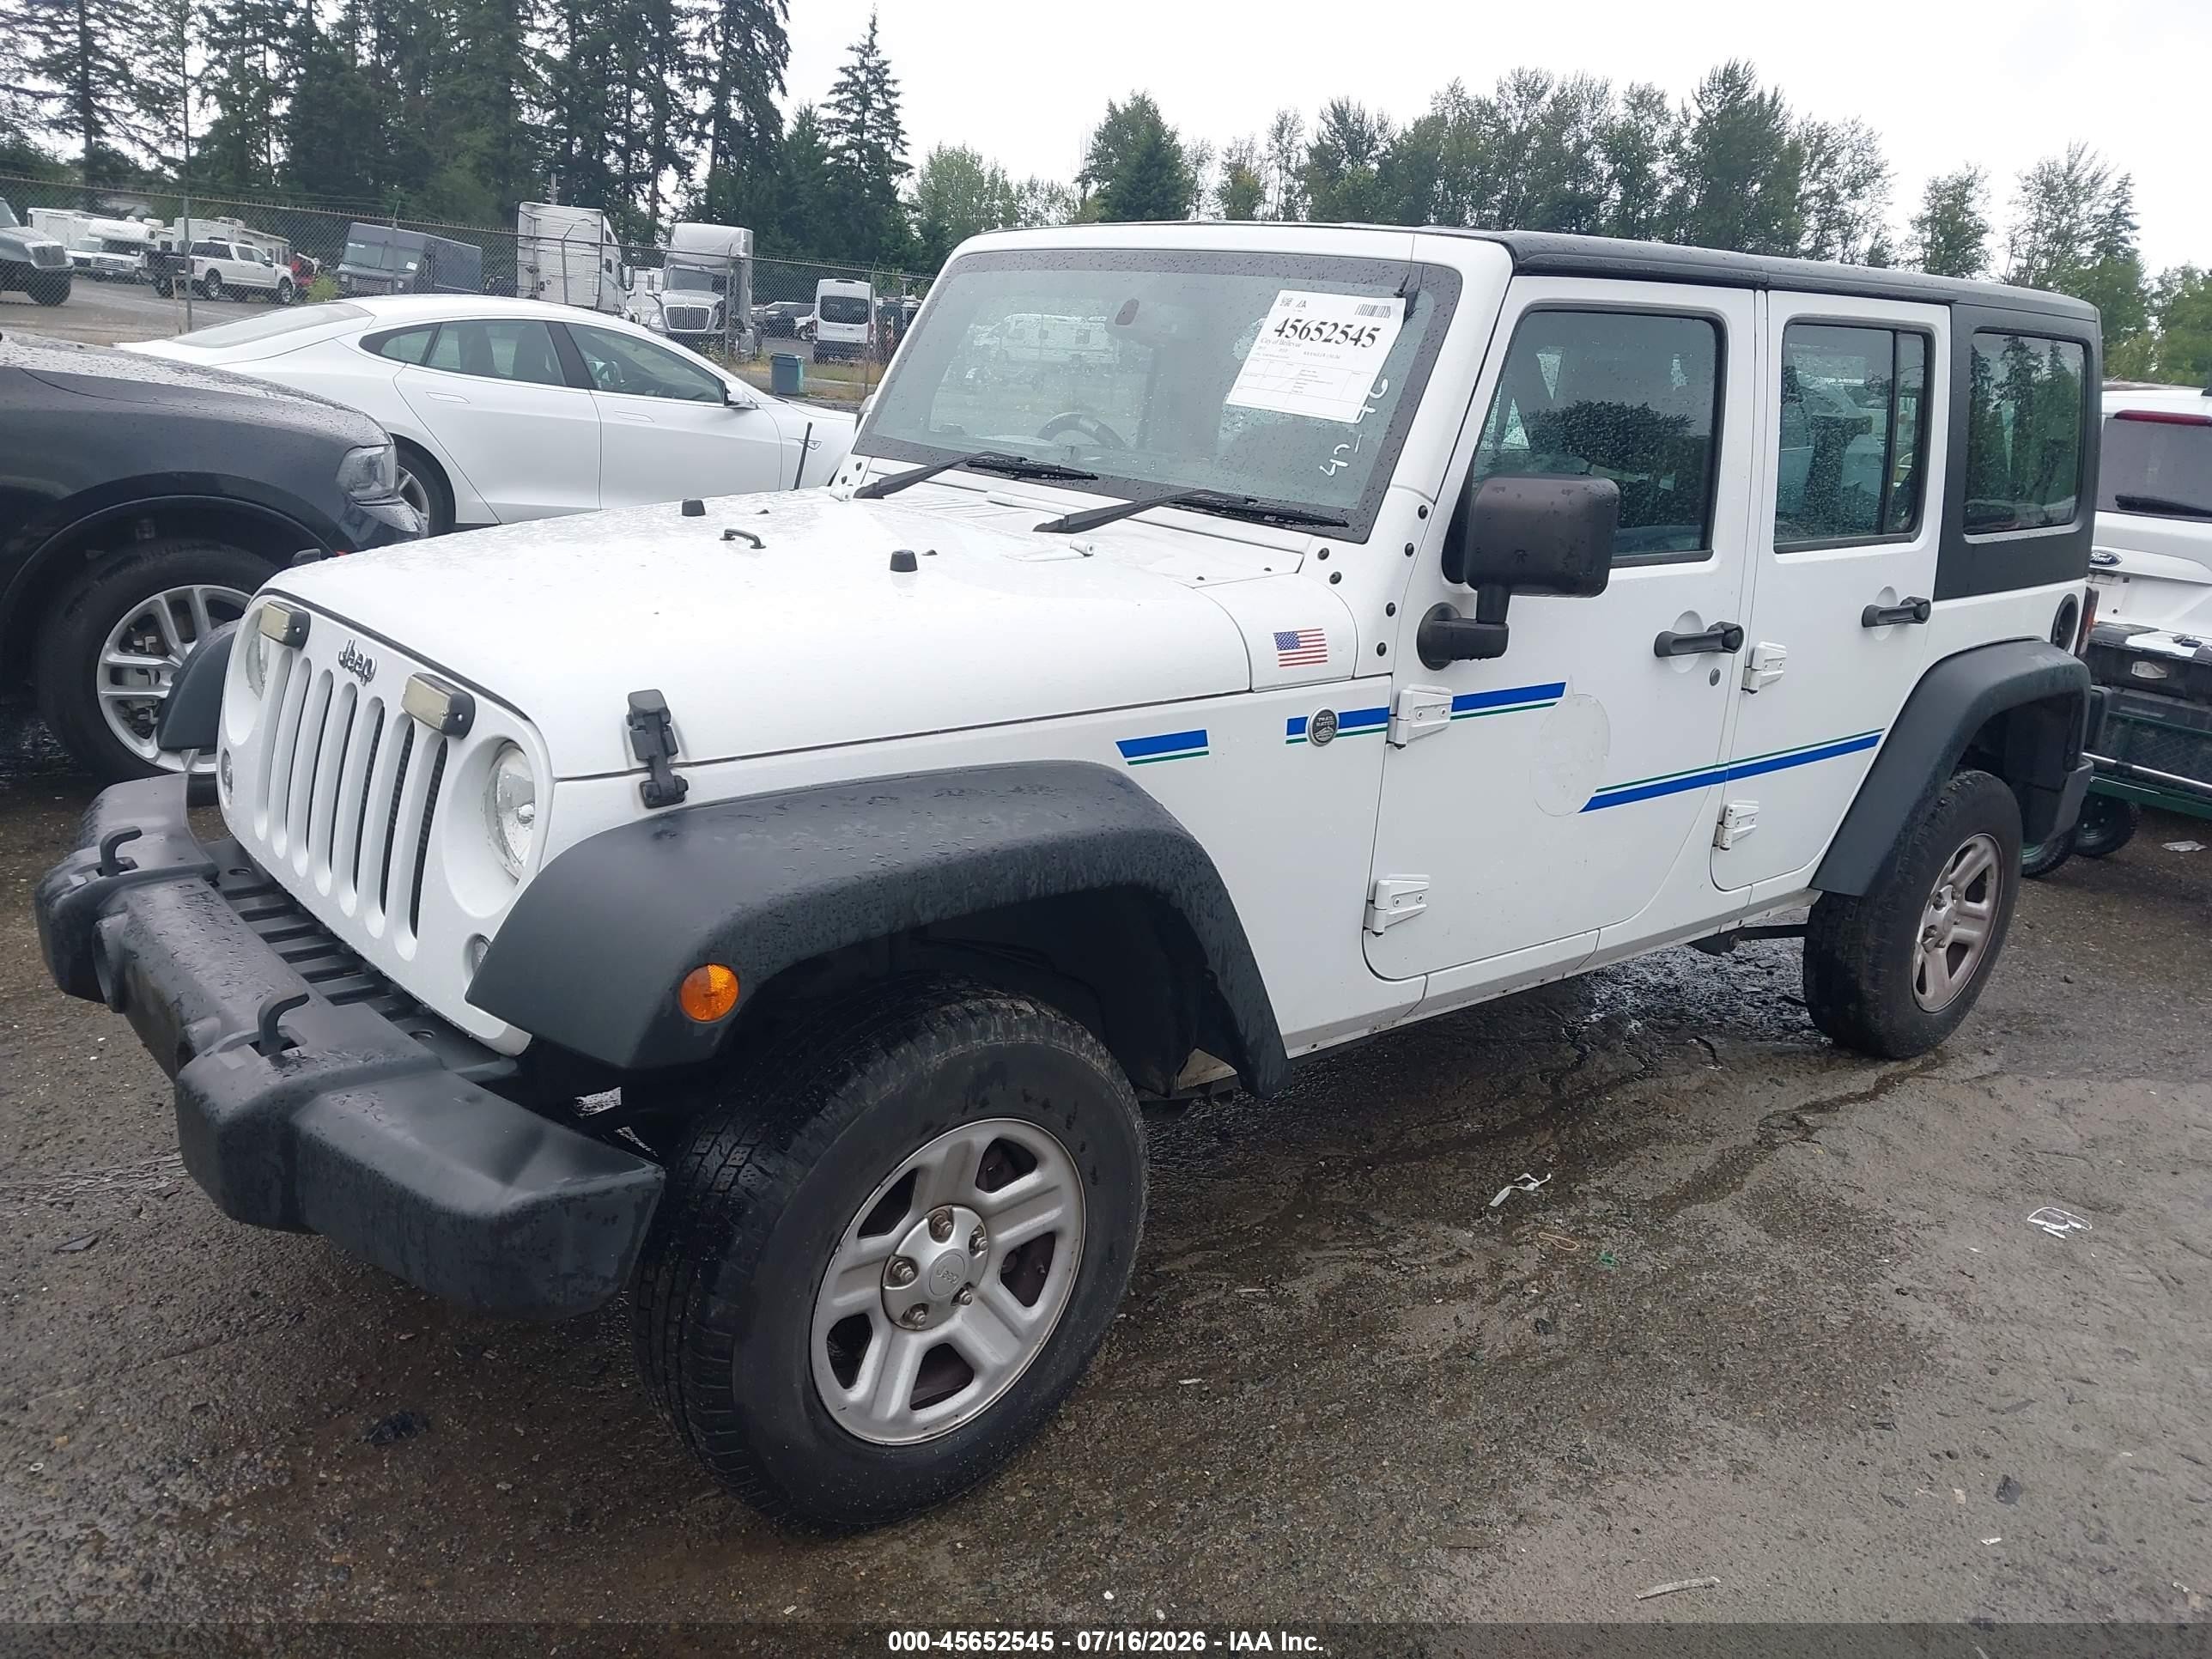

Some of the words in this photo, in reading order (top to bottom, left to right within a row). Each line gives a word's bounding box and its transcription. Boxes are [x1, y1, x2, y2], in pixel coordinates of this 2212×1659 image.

[1274, 317, 1381, 348] 45652545
[338, 639, 377, 686] Jeep
[936, 1265, 959, 1285] Jeep
